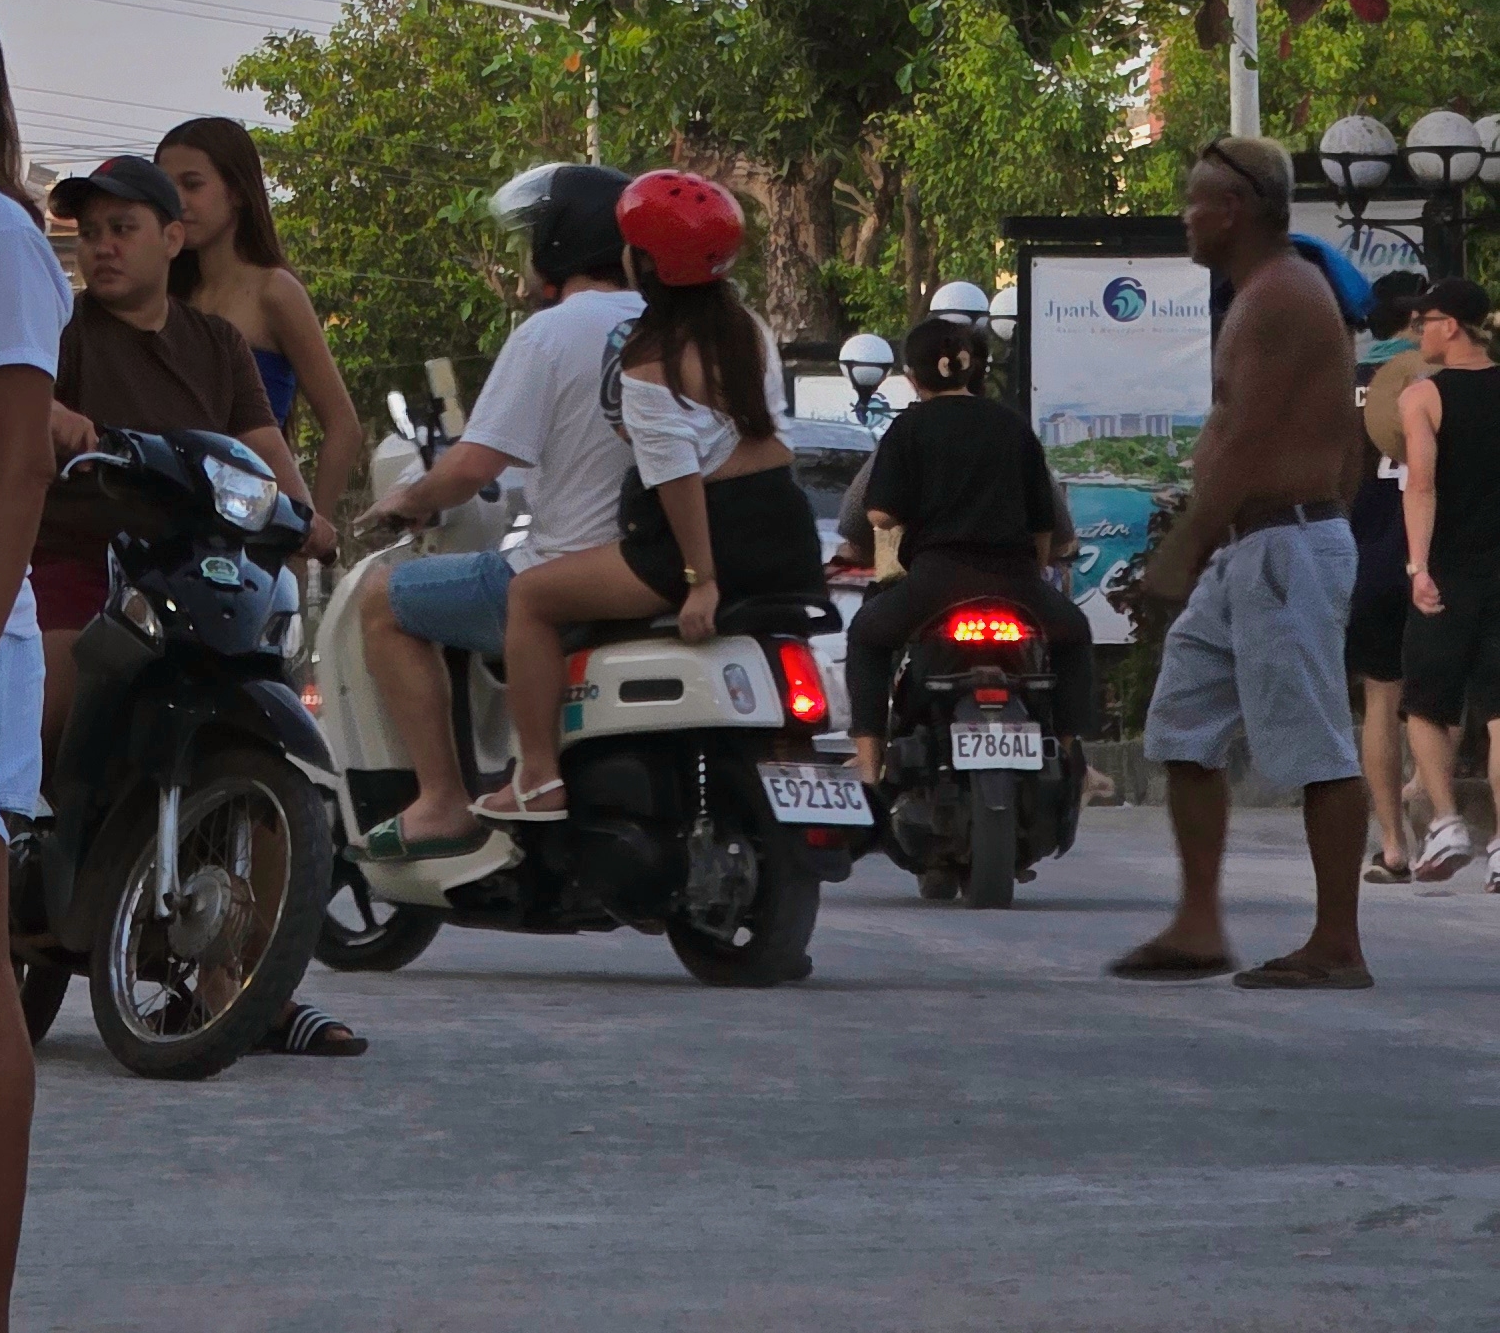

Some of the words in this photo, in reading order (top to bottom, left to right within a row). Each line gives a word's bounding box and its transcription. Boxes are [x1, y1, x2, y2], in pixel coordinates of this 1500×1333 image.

[1045, 300, 1100, 323] Jpark
[957, 734, 1037, 758] E786AL
[769, 778, 863, 810] E9213C
